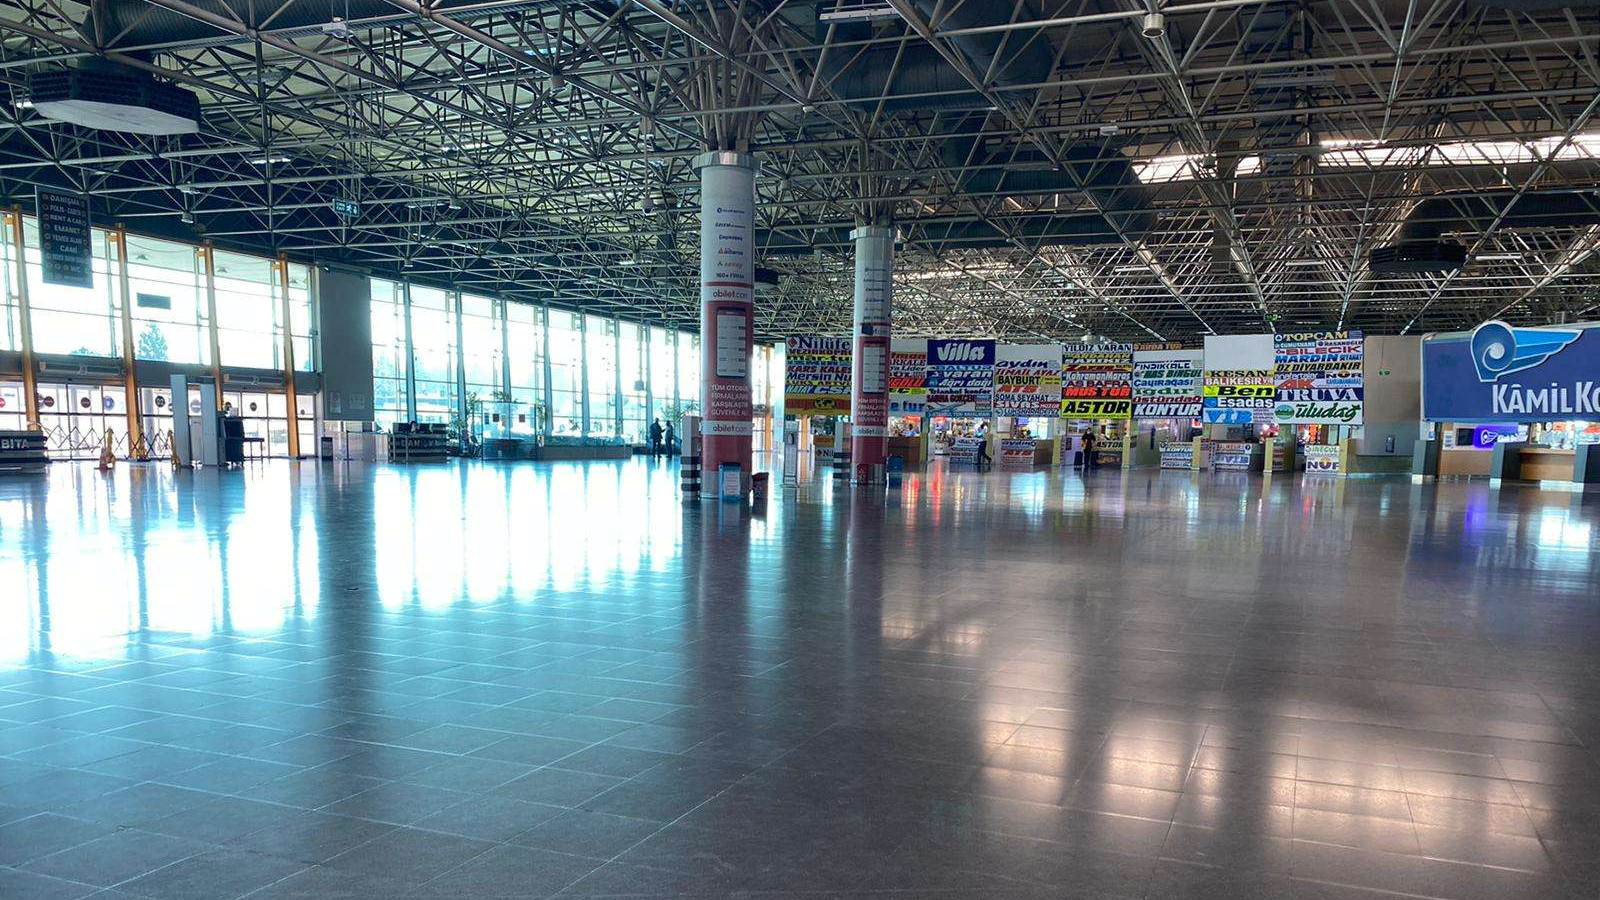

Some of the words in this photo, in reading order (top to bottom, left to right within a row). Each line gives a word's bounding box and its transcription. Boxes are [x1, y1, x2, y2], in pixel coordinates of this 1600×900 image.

[937, 343, 985, 361] Villa
[998, 376, 1041, 384] BAYBURT
[1218, 387, 1273, 395] Ben
[1278, 389, 1358, 401] TRUVA
[1063, 401, 1129, 413] ASTOR
[1134, 404, 1202, 416] KONTUR
